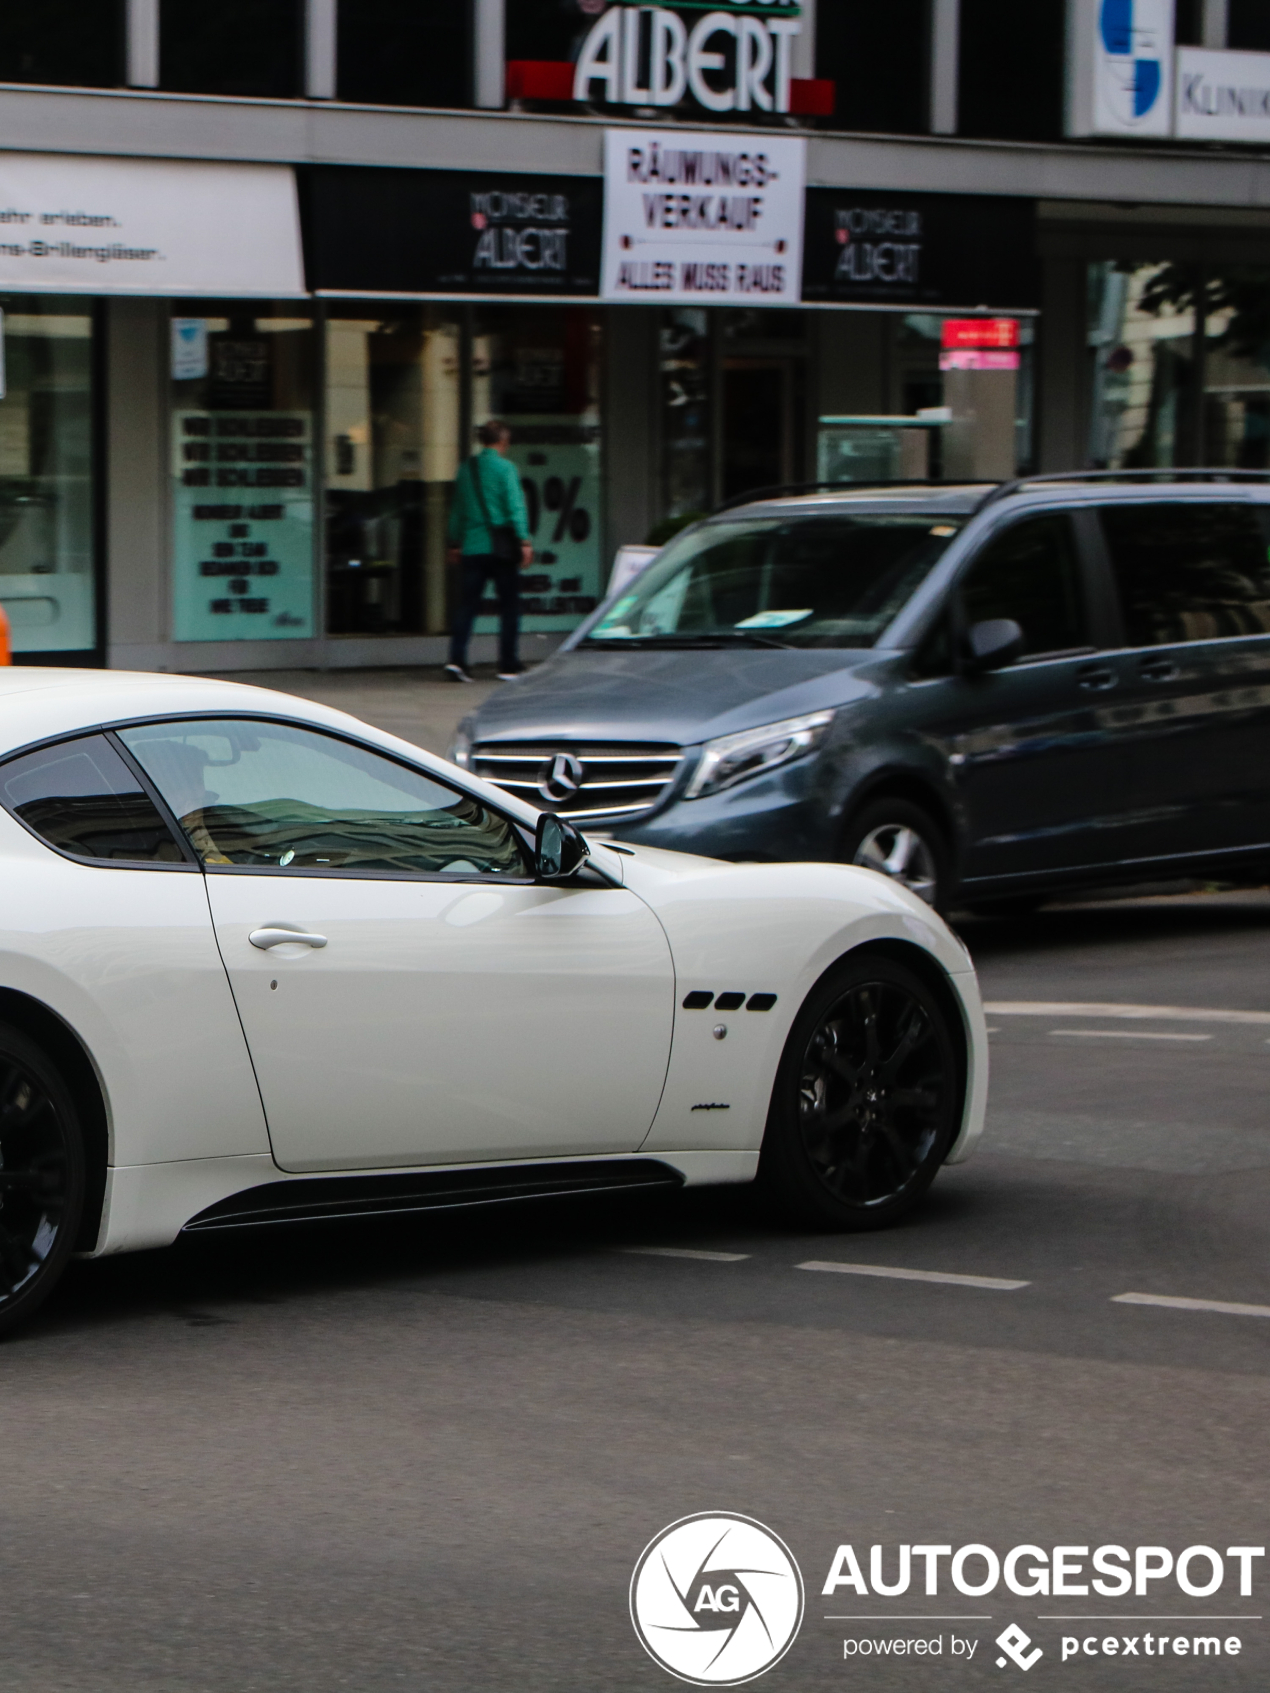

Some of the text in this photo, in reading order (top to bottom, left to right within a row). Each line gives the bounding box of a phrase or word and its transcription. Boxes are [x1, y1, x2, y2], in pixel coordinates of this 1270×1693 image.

[573, 6, 801, 112] ALBERT
[628, 141, 778, 187] RÄUMUNGS-
[644, 193, 761, 231] VERKAUF
[616, 262, 673, 291] ALLES
[682, 263, 730, 292] MUSS
[735, 264, 786, 293] RAUS
